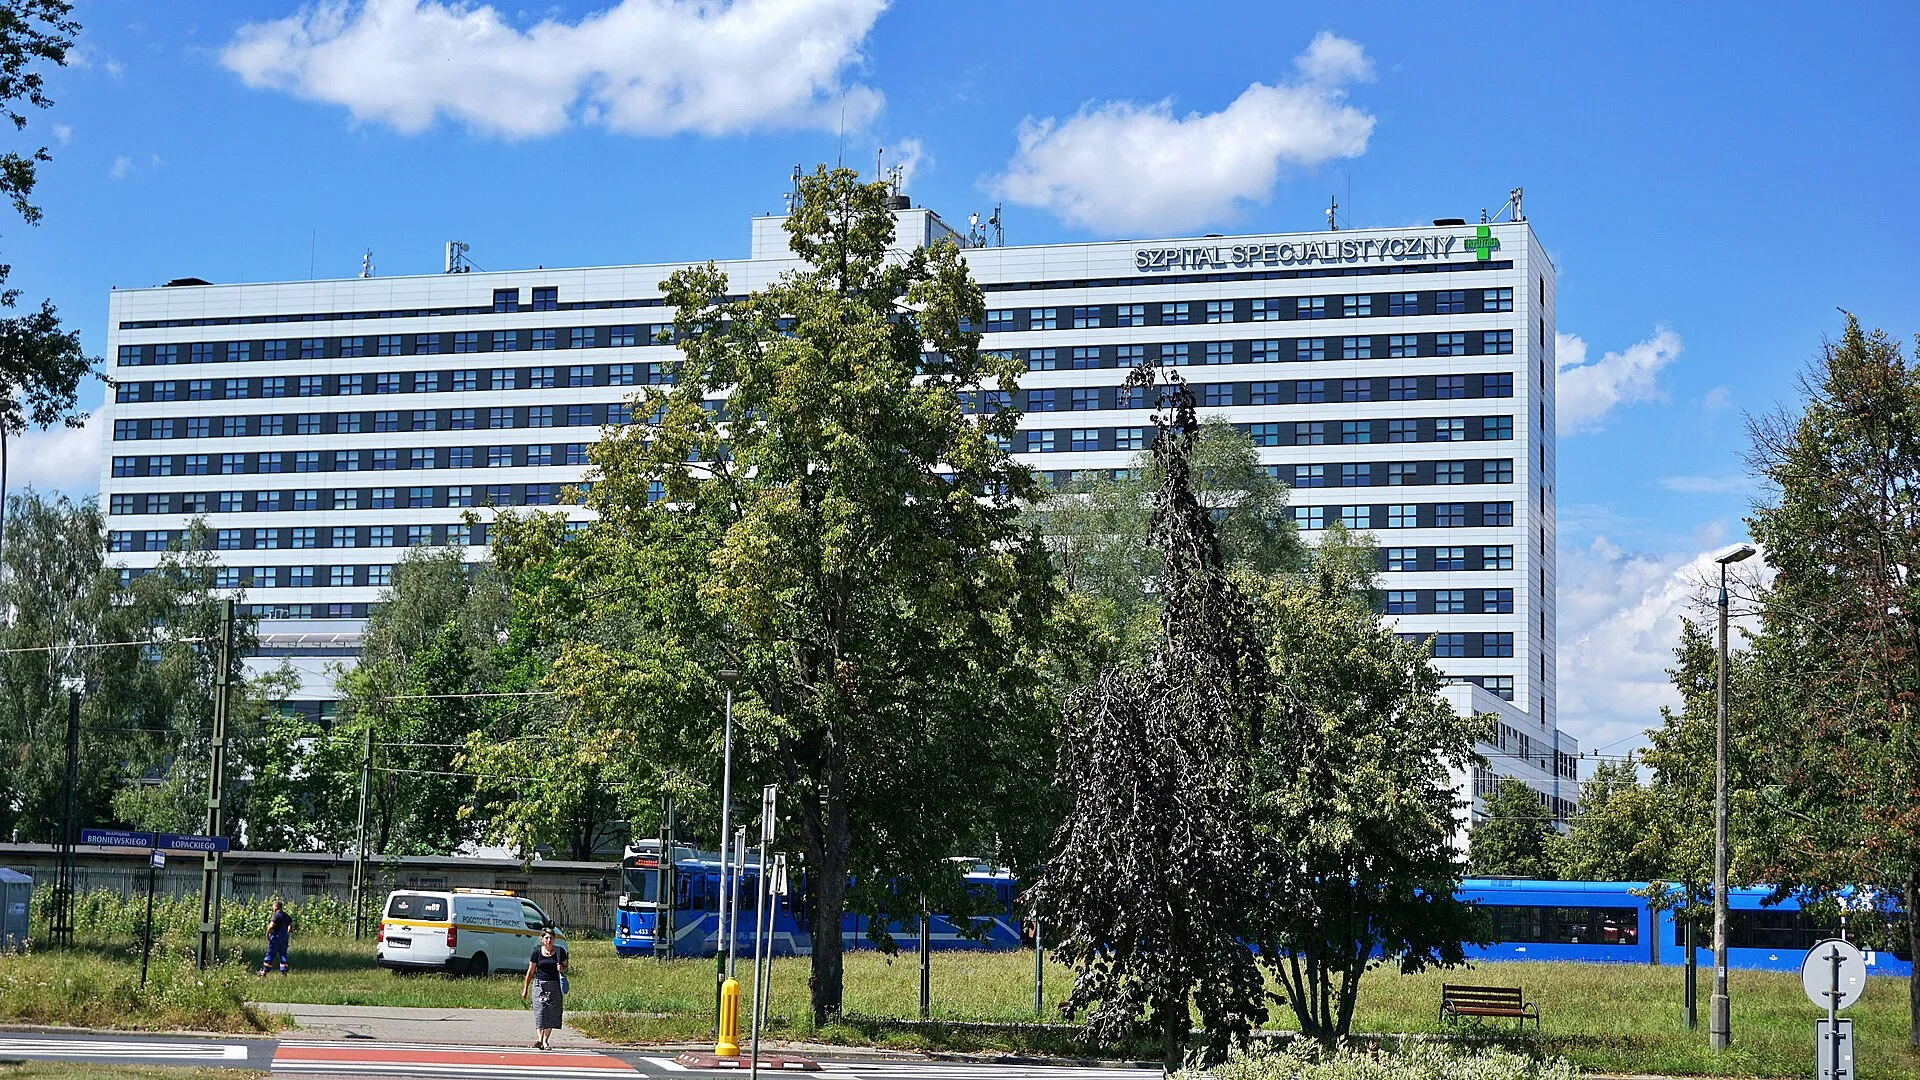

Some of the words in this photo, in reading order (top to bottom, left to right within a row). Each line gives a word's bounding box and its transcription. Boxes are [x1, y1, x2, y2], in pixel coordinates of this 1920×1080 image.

[1135, 246, 1225, 268] SZPITAL
[1230, 235, 1454, 265] SPECJALISTYCZNY
[87, 835, 147, 846] BRONIEWSKIEGO
[171, 840, 216, 850] ŁOPACKIEGO
[462, 916, 491, 926] POGOTOWIE
[493, 919, 520, 928] TECHNICZNE
